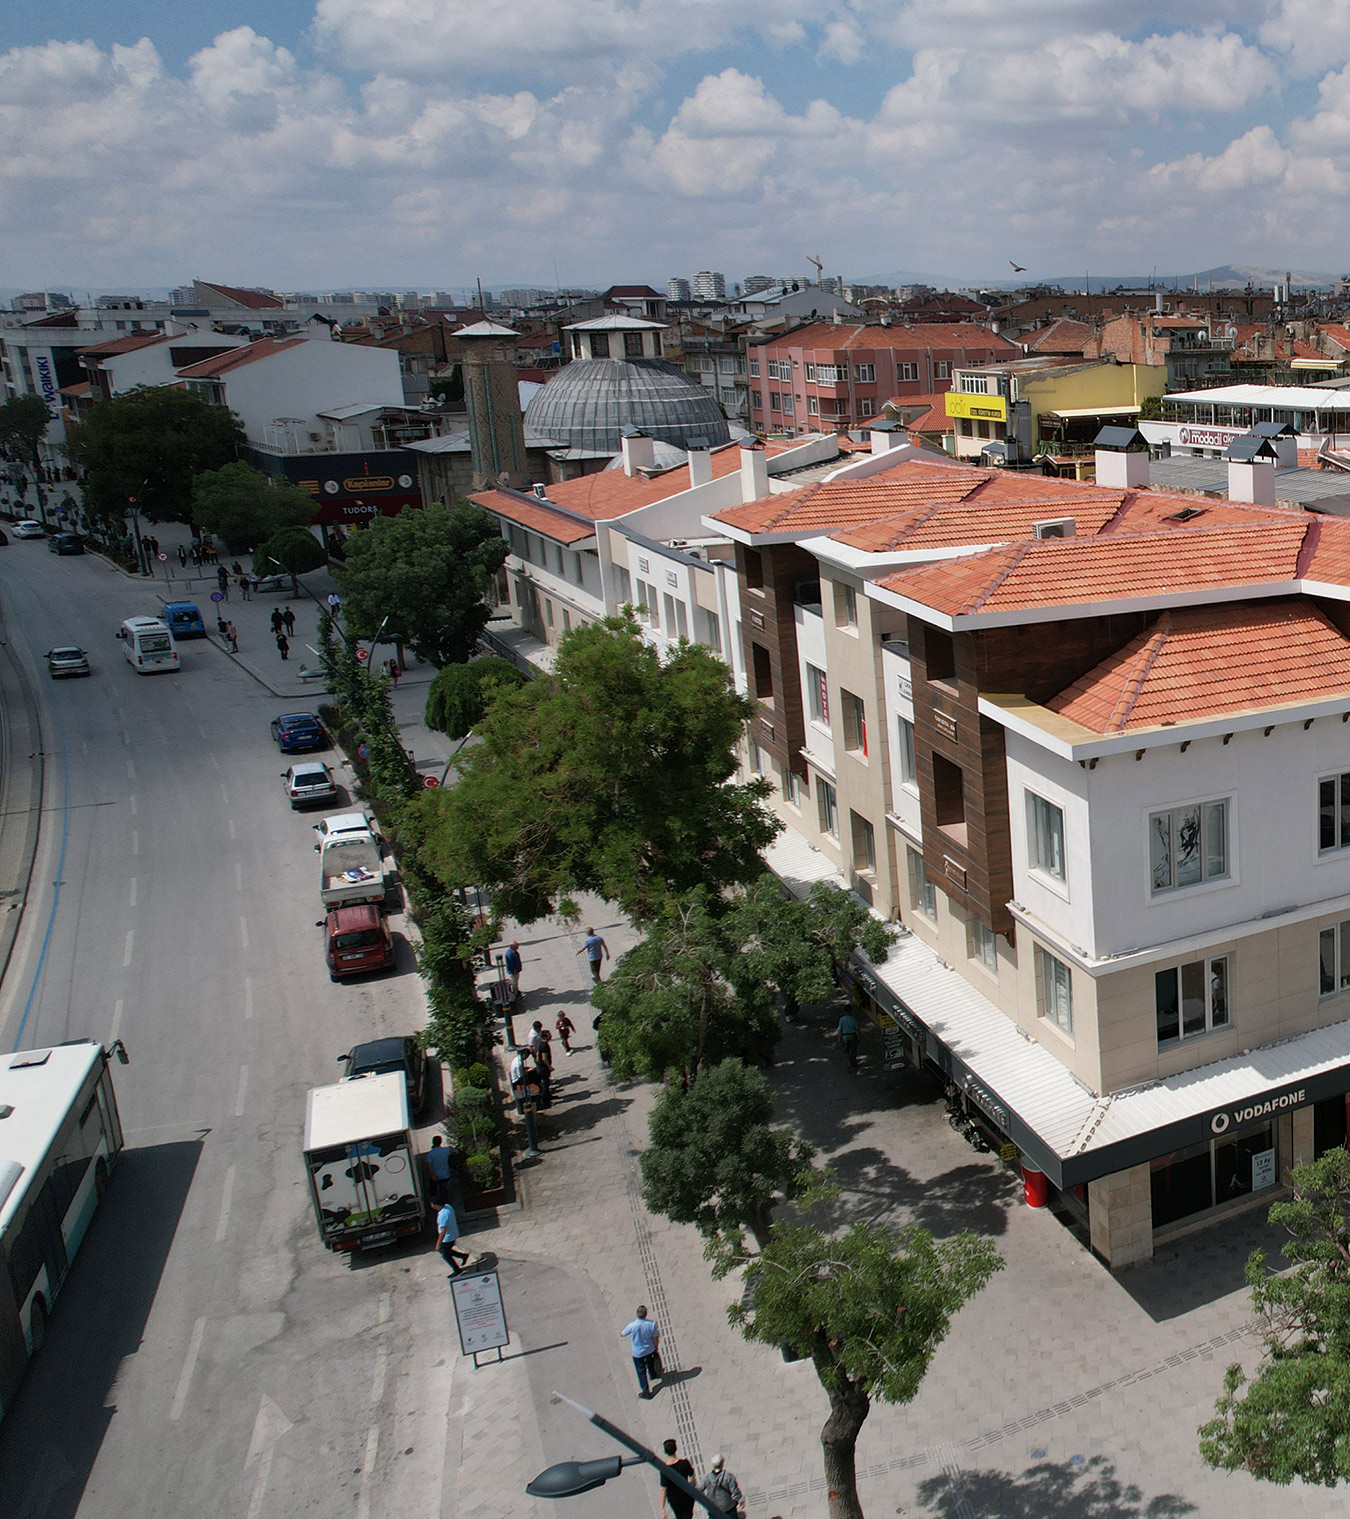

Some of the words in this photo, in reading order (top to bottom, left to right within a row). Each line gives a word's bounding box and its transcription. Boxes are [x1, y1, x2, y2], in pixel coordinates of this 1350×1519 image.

[342, 505, 379, 515] TUDORS
[1234, 1089, 1306, 1124] VODAFONE
[1256, 1159, 1263, 1167] 12
